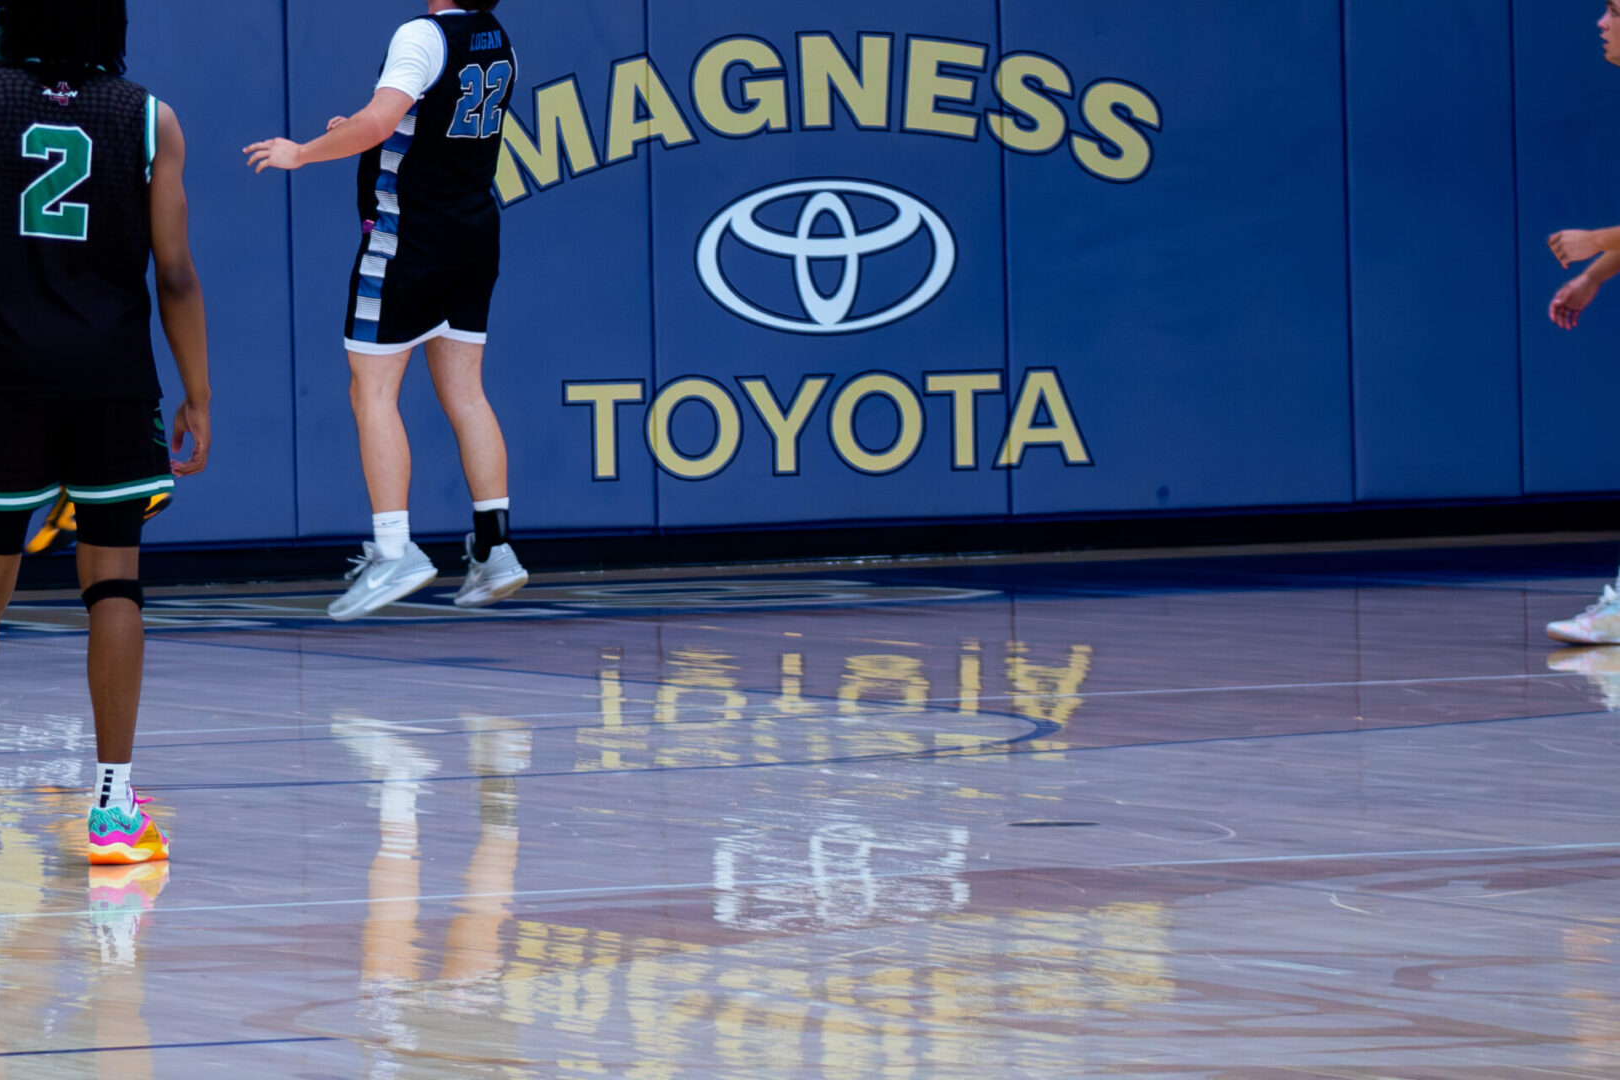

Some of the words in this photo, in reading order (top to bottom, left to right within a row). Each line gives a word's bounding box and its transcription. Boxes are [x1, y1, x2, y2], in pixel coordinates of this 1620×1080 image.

[469, 29, 503, 52] LOGAN
[446, 59, 513, 139] 22
[491, 33, 1161, 206] MAGNESS
[19, 122, 93, 242] 2
[563, 368, 1090, 480] TOYOTA
